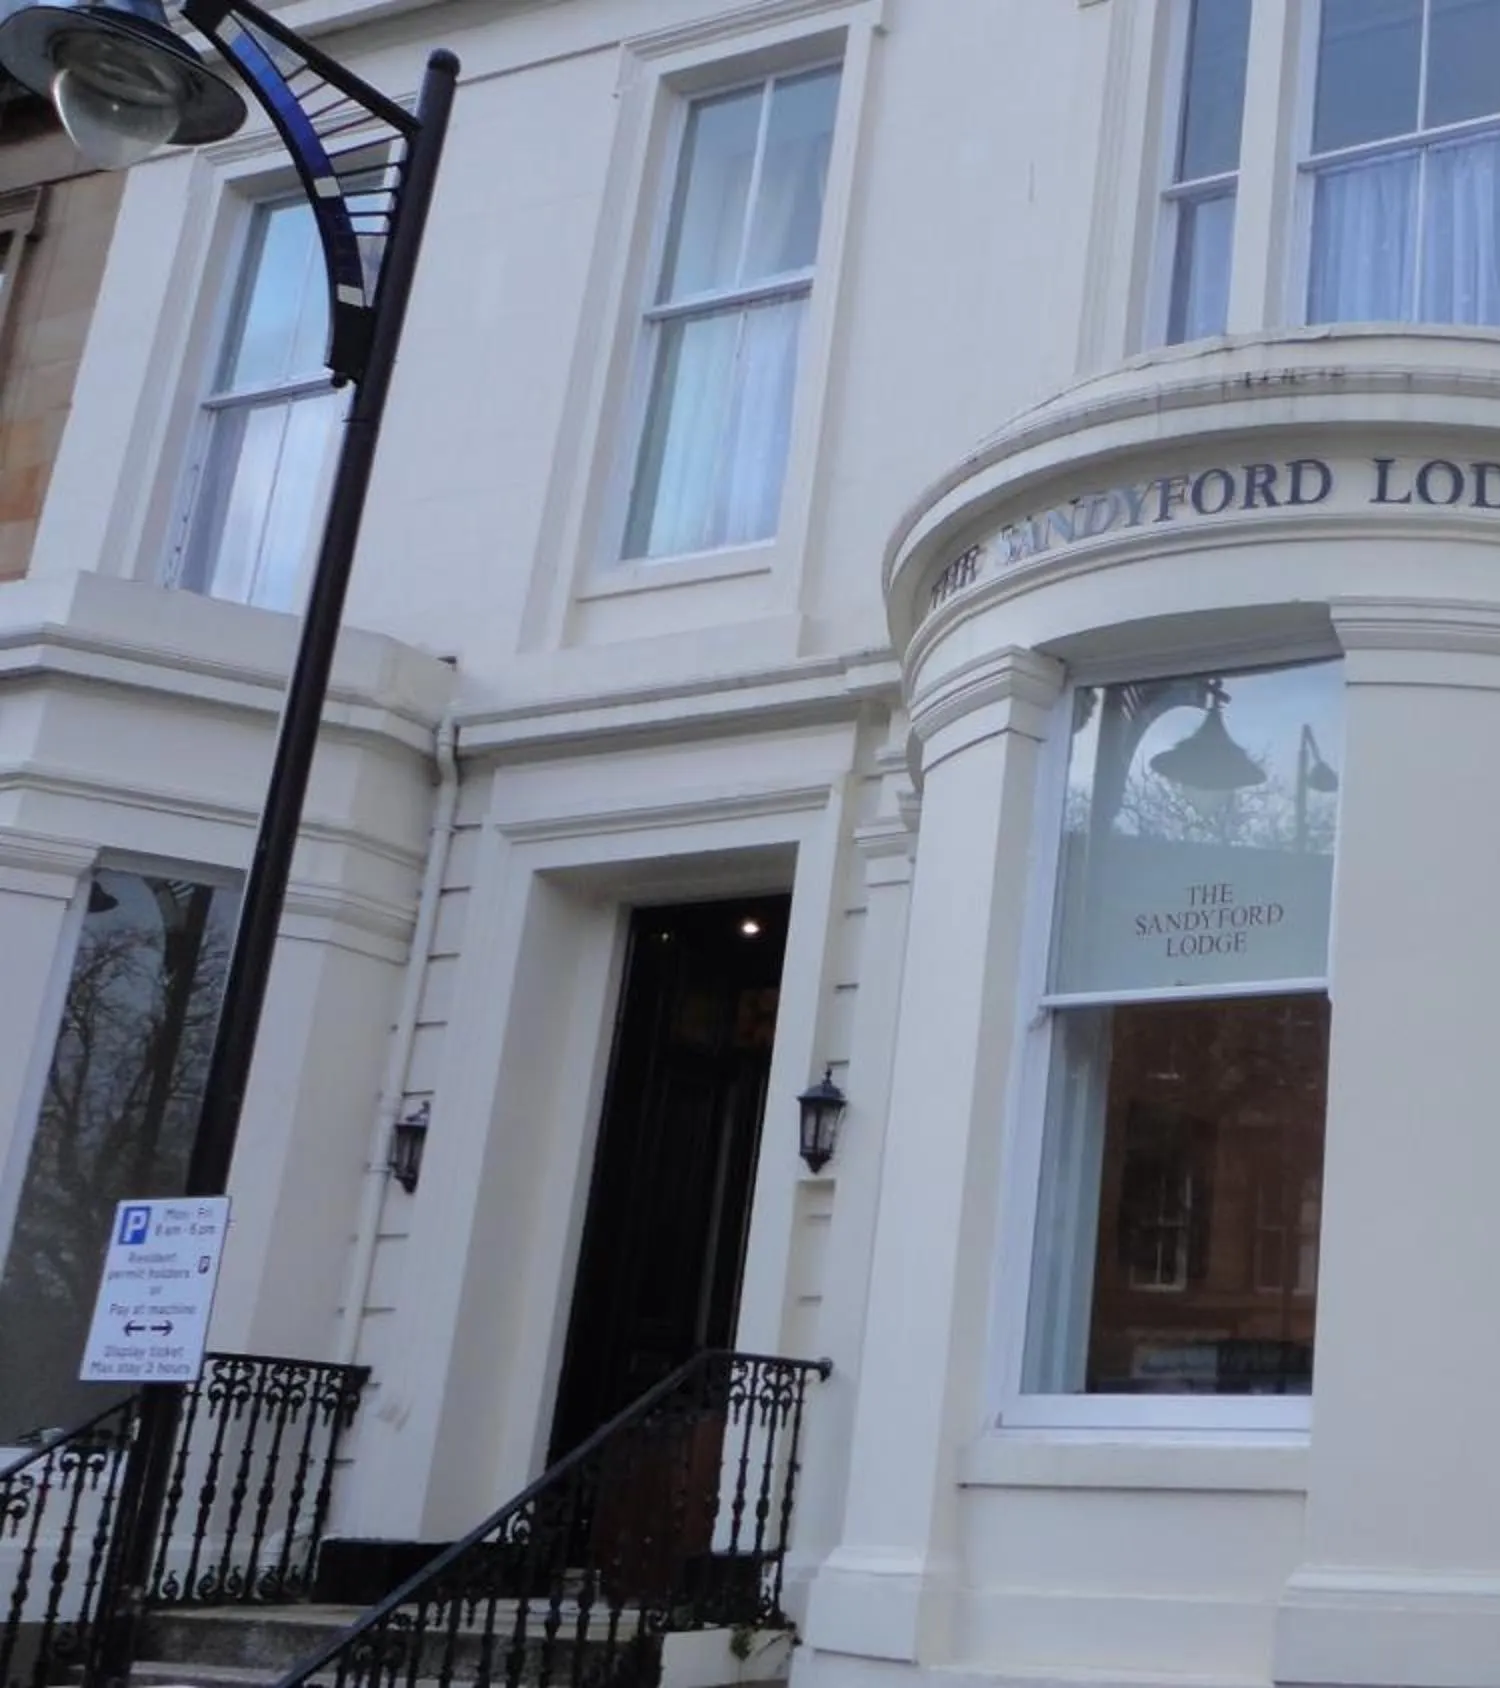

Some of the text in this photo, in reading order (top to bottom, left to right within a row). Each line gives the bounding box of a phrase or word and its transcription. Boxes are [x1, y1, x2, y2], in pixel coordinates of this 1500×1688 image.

[998, 458, 1334, 565] SANDYFORD
[1187, 883, 1234, 906] THE
[1135, 902, 1285, 936] SANDYFORD
[1166, 931, 1249, 958] LODGE
[121, 1208, 149, 1243] P
[109, 1303, 129, 1316] Pay
